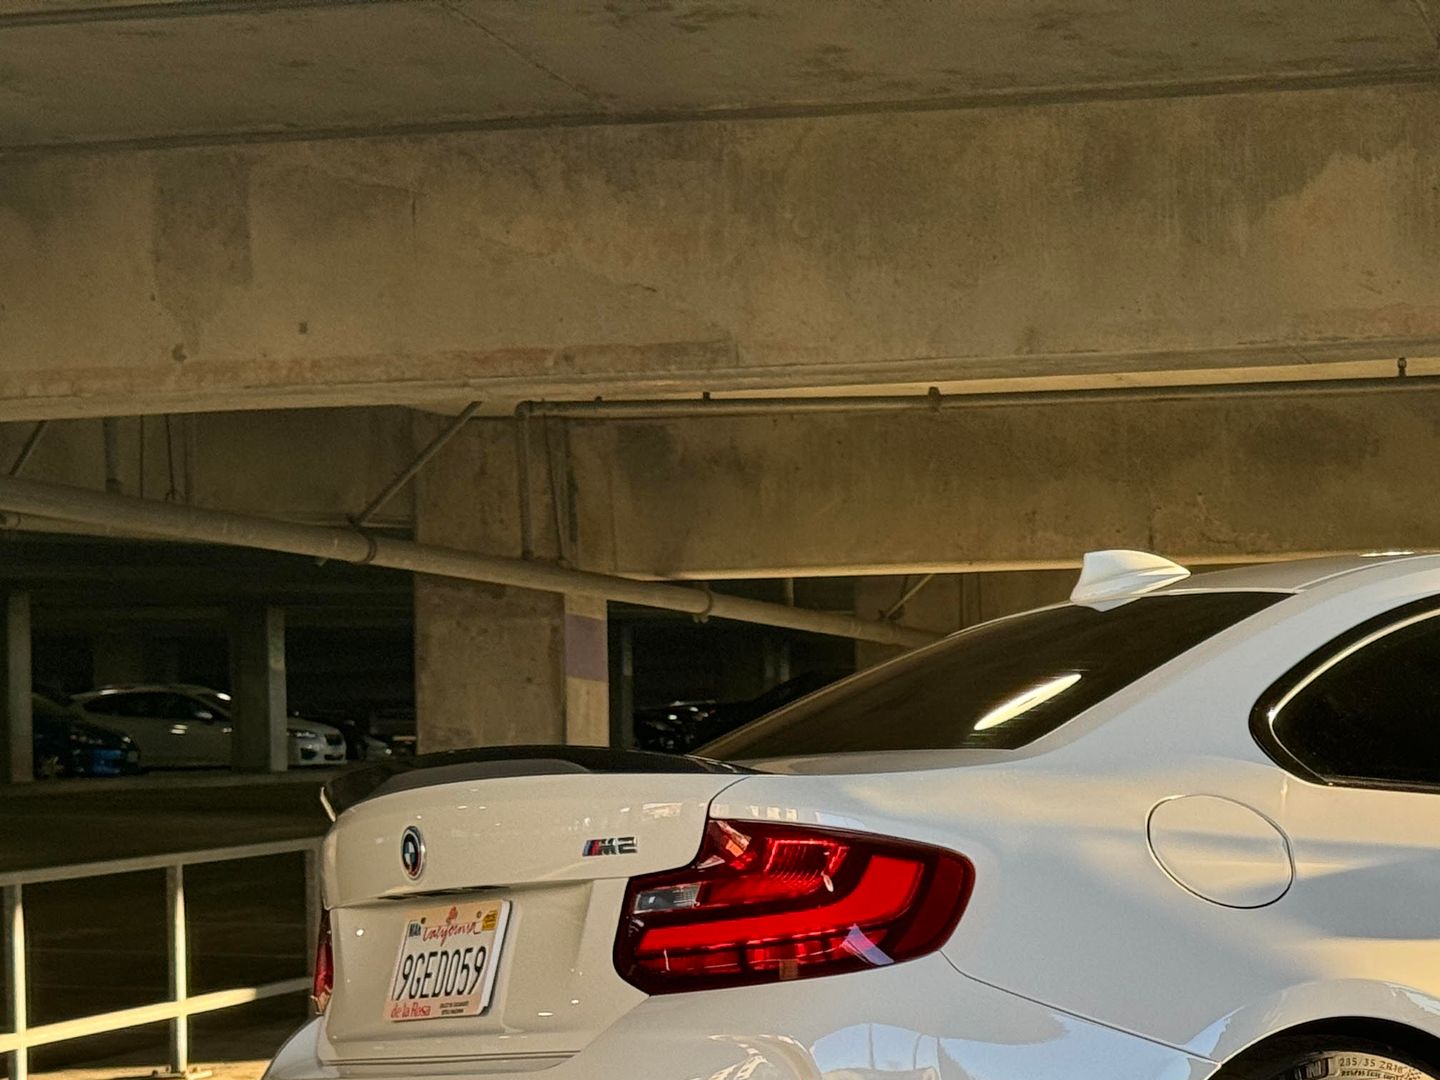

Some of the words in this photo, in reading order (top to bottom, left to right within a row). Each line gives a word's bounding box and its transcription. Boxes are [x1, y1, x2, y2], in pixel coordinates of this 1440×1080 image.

[587, 836, 638, 857] M2
[422, 921, 482, 947] California
[396, 946, 487, 1001] 9GED059
